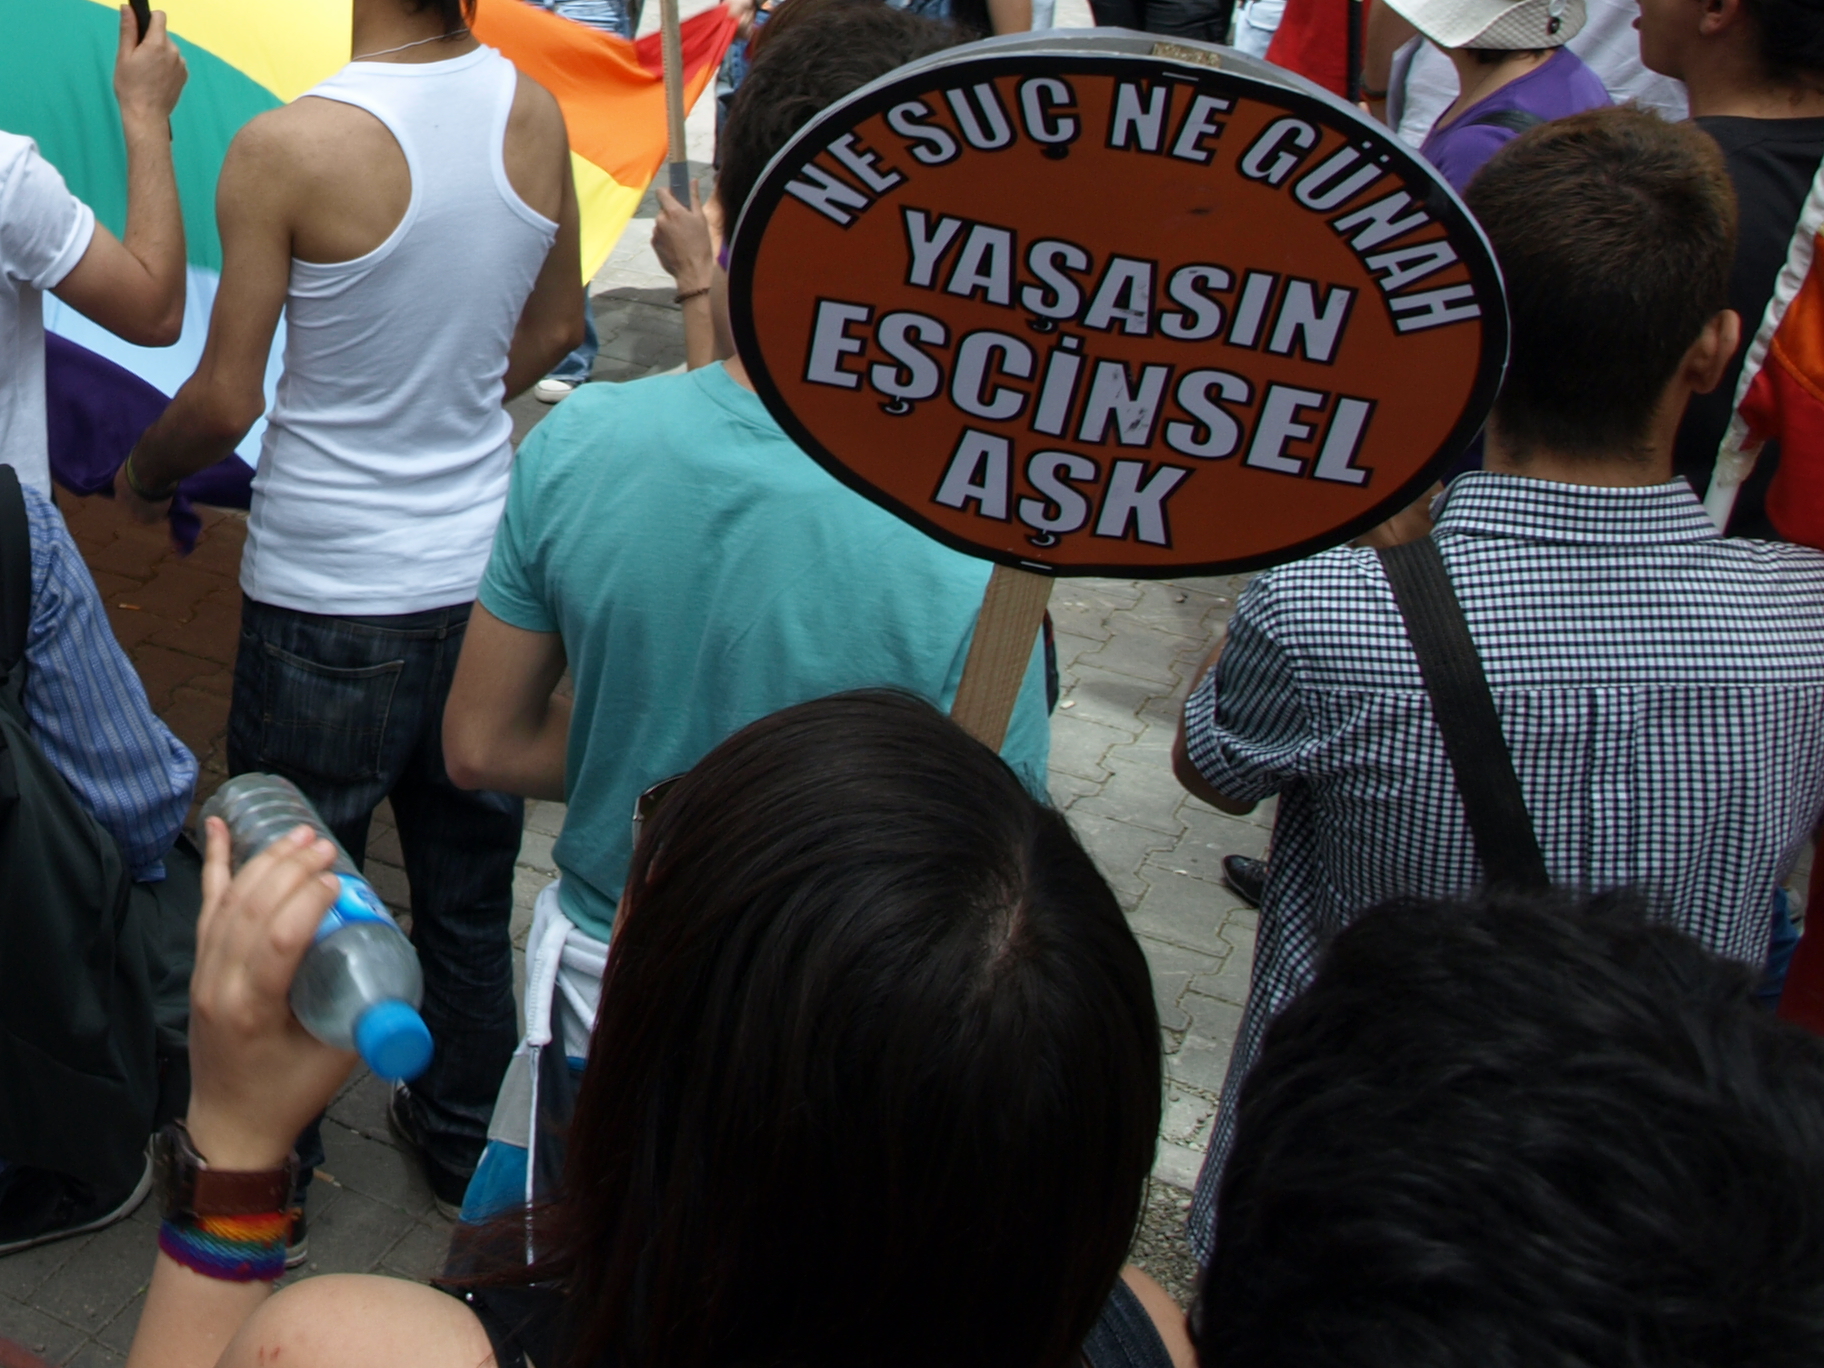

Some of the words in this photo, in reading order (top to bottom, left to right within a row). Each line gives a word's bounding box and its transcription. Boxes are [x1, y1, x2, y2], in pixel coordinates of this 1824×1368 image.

[781, 132, 907, 229] NE
[884, 75, 1079, 166] SUÇ
[1108, 79, 1234, 166] NE
[1239, 115, 1482, 336] GÜNAH
[900, 204, 1360, 366] YAŞASIN
[801, 295, 1380, 489] EŞCİNSEL
[929, 424, 1195, 550] AŞK
